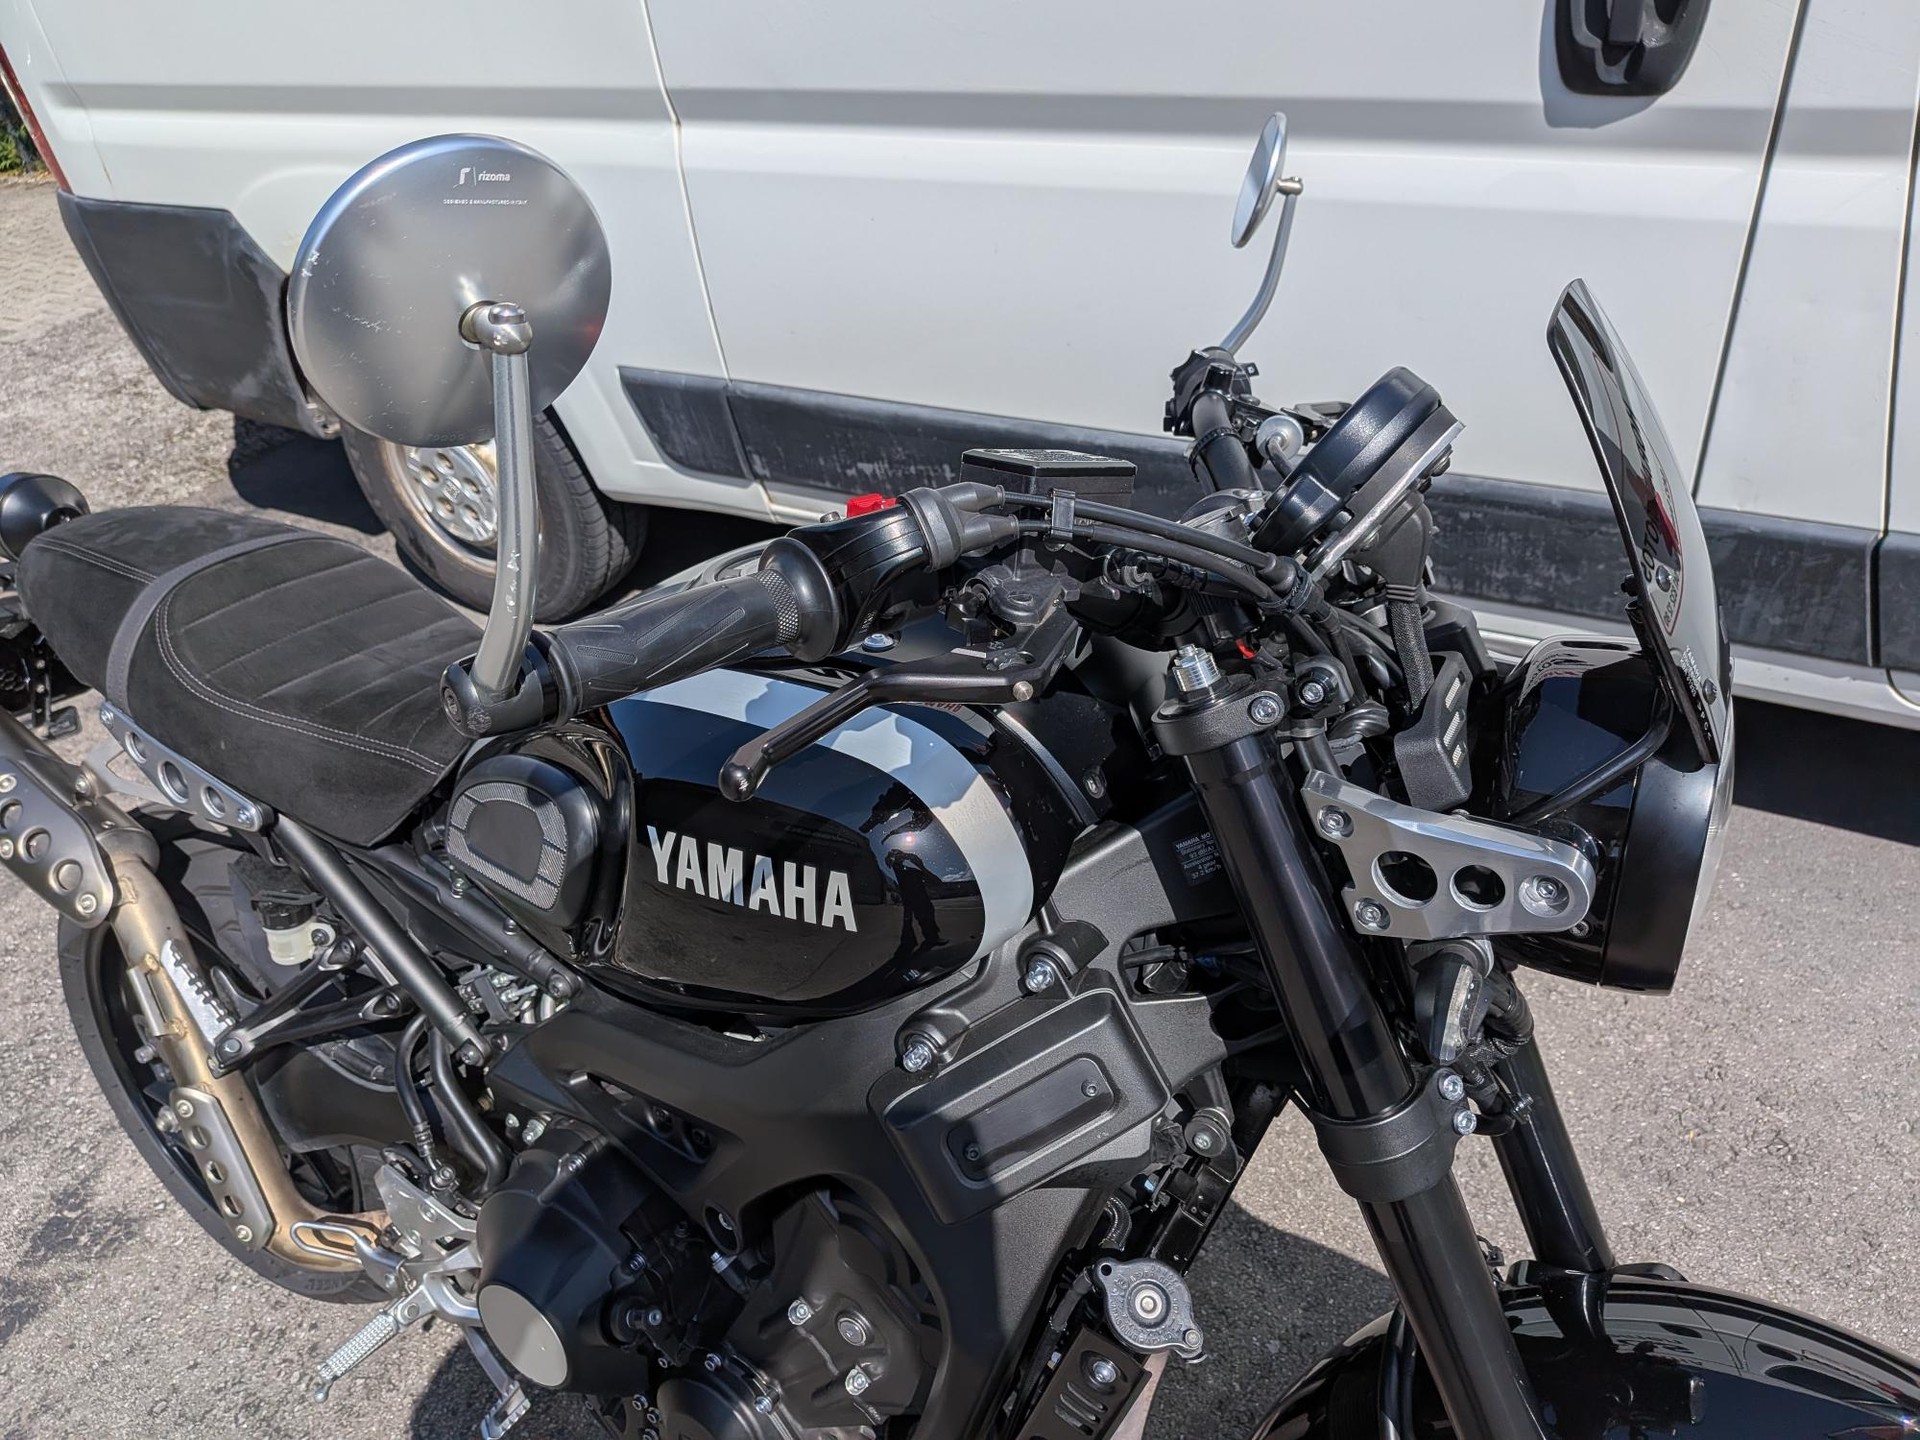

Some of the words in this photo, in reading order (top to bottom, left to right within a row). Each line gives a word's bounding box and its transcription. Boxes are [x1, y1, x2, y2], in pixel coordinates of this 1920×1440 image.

[478, 170, 511, 182] rizoma
[1175, 837, 1200, 849] YAMAHA
[646, 825, 858, 932] YAMAHA
